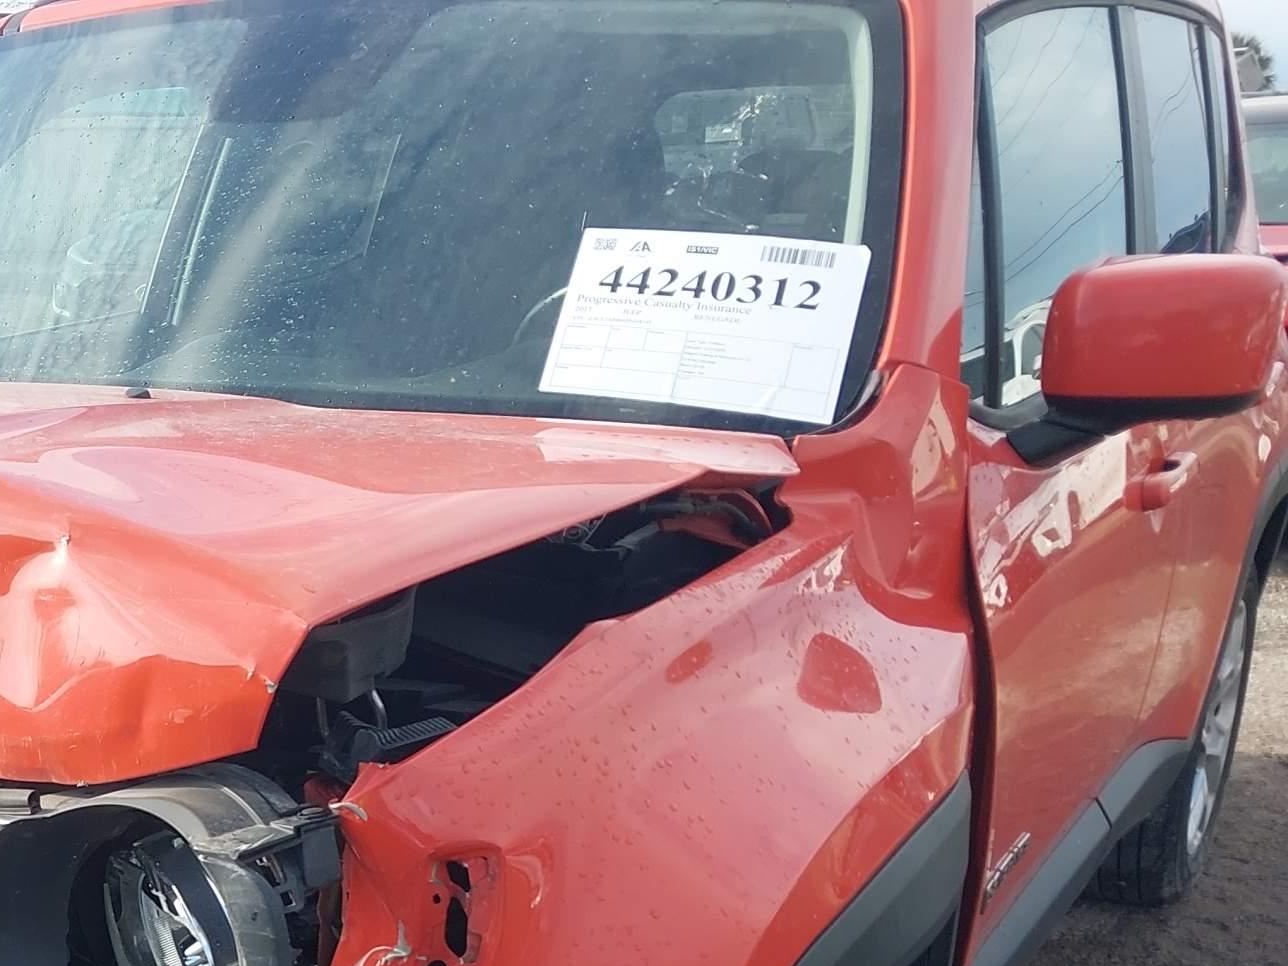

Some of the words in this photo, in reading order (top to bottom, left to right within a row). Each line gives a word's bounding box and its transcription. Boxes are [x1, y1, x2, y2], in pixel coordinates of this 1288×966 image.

[599, 265, 822, 310] 44240312
[577, 294, 640, 305] Progressive
[644, 297, 692, 311] Casualty
[697, 301, 752, 315] Insurance
